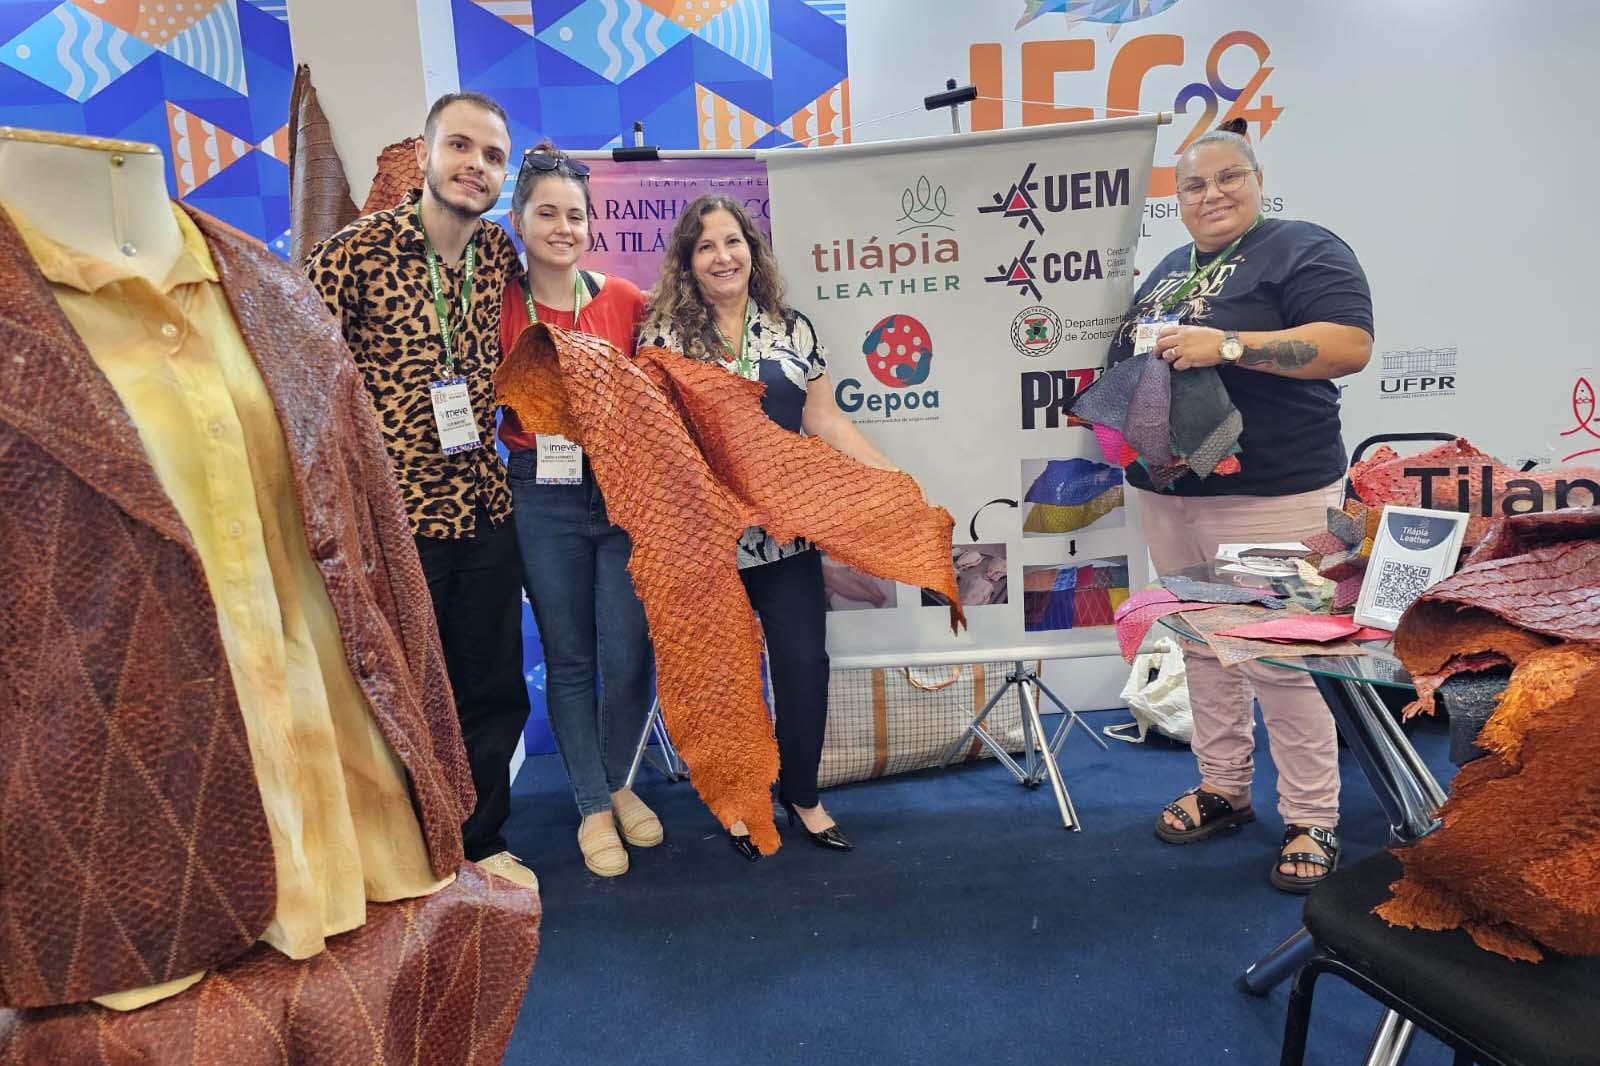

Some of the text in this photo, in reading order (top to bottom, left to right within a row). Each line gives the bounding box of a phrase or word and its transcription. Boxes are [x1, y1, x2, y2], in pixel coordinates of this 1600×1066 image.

[1044, 168, 1130, 213] UEM
[615, 227, 666, 252] TILÁ
[811, 232, 960, 274] tilápia
[1043, 249, 1104, 284] CCA
[816, 275, 960, 301] LEATHER
[1065, 329, 1114, 342] de Zootec
[835, 378, 940, 418] Gepoa
[1380, 376, 1456, 393] UFPR
